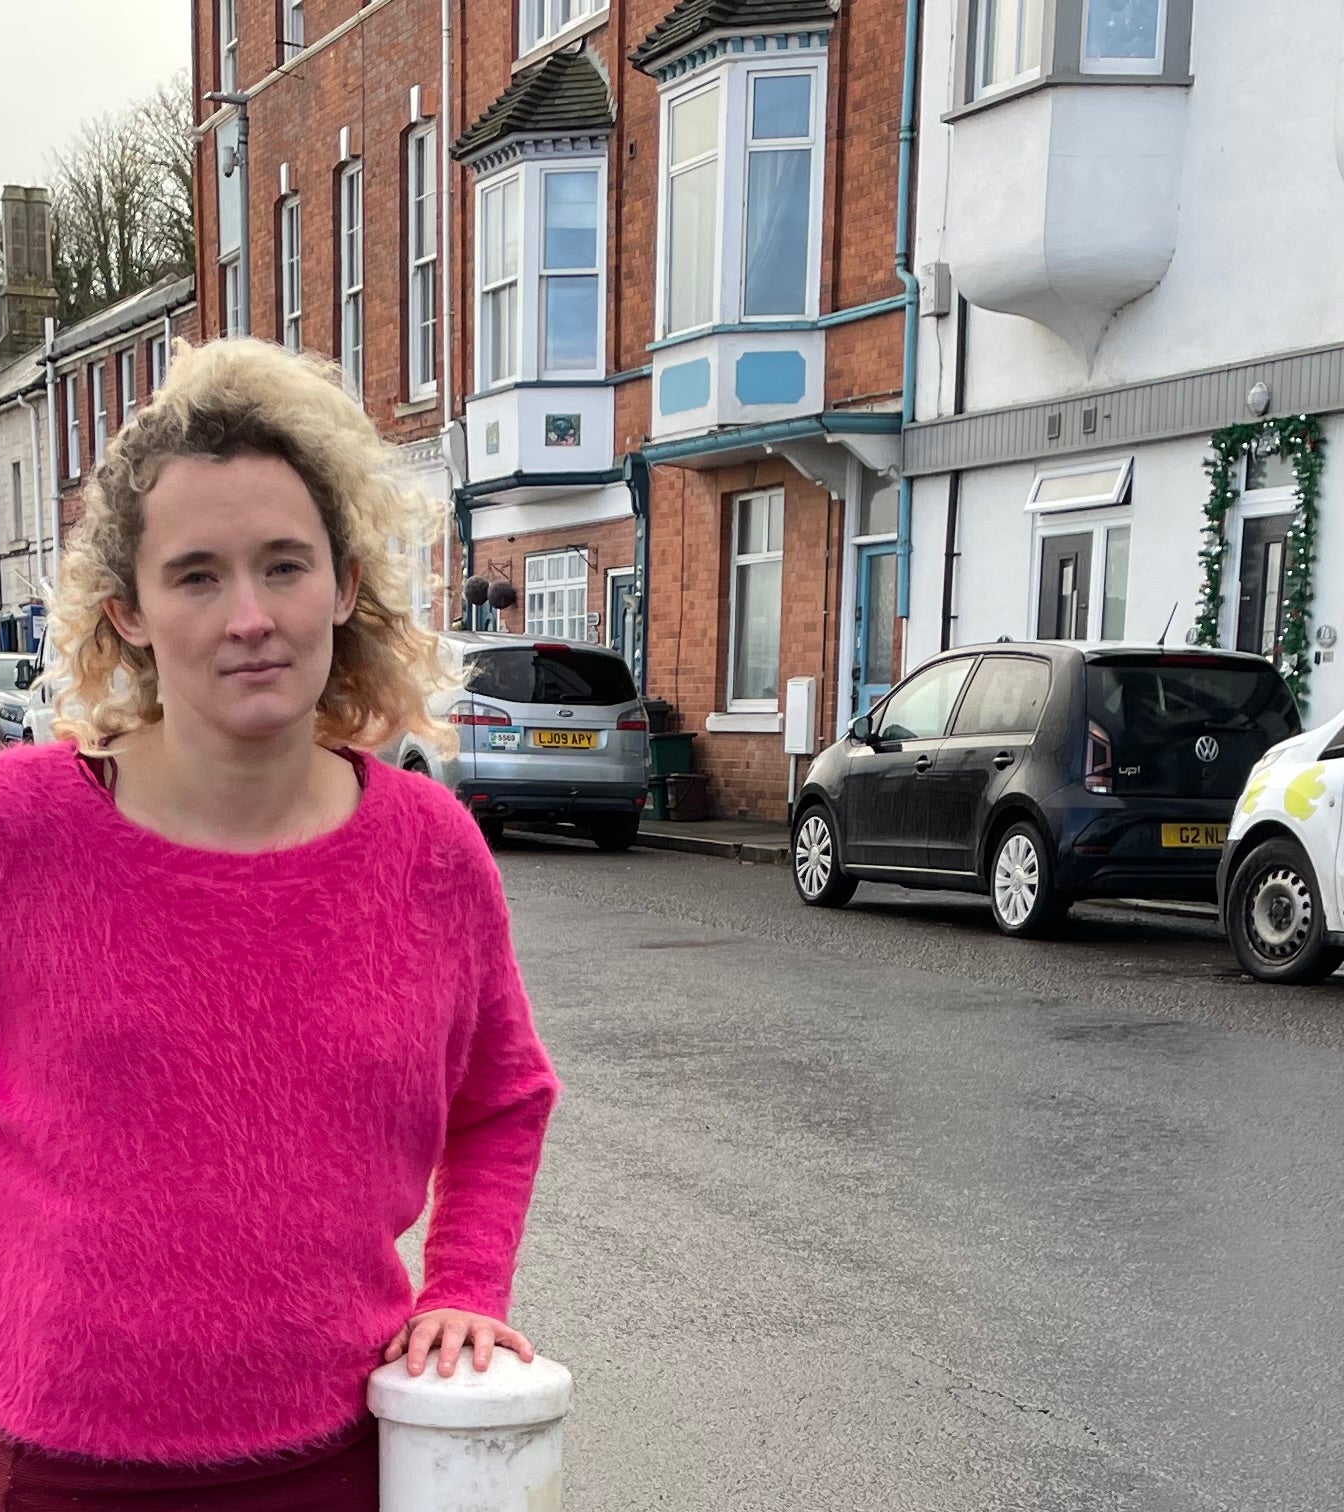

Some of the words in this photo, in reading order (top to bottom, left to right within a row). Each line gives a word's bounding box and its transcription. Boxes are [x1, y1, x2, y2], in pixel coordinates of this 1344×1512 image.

[538, 732, 568, 744] LJ09
[571, 733, 594, 746] APY
[1179, 827, 1199, 844] G2
[1206, 827, 1228, 844] NL
